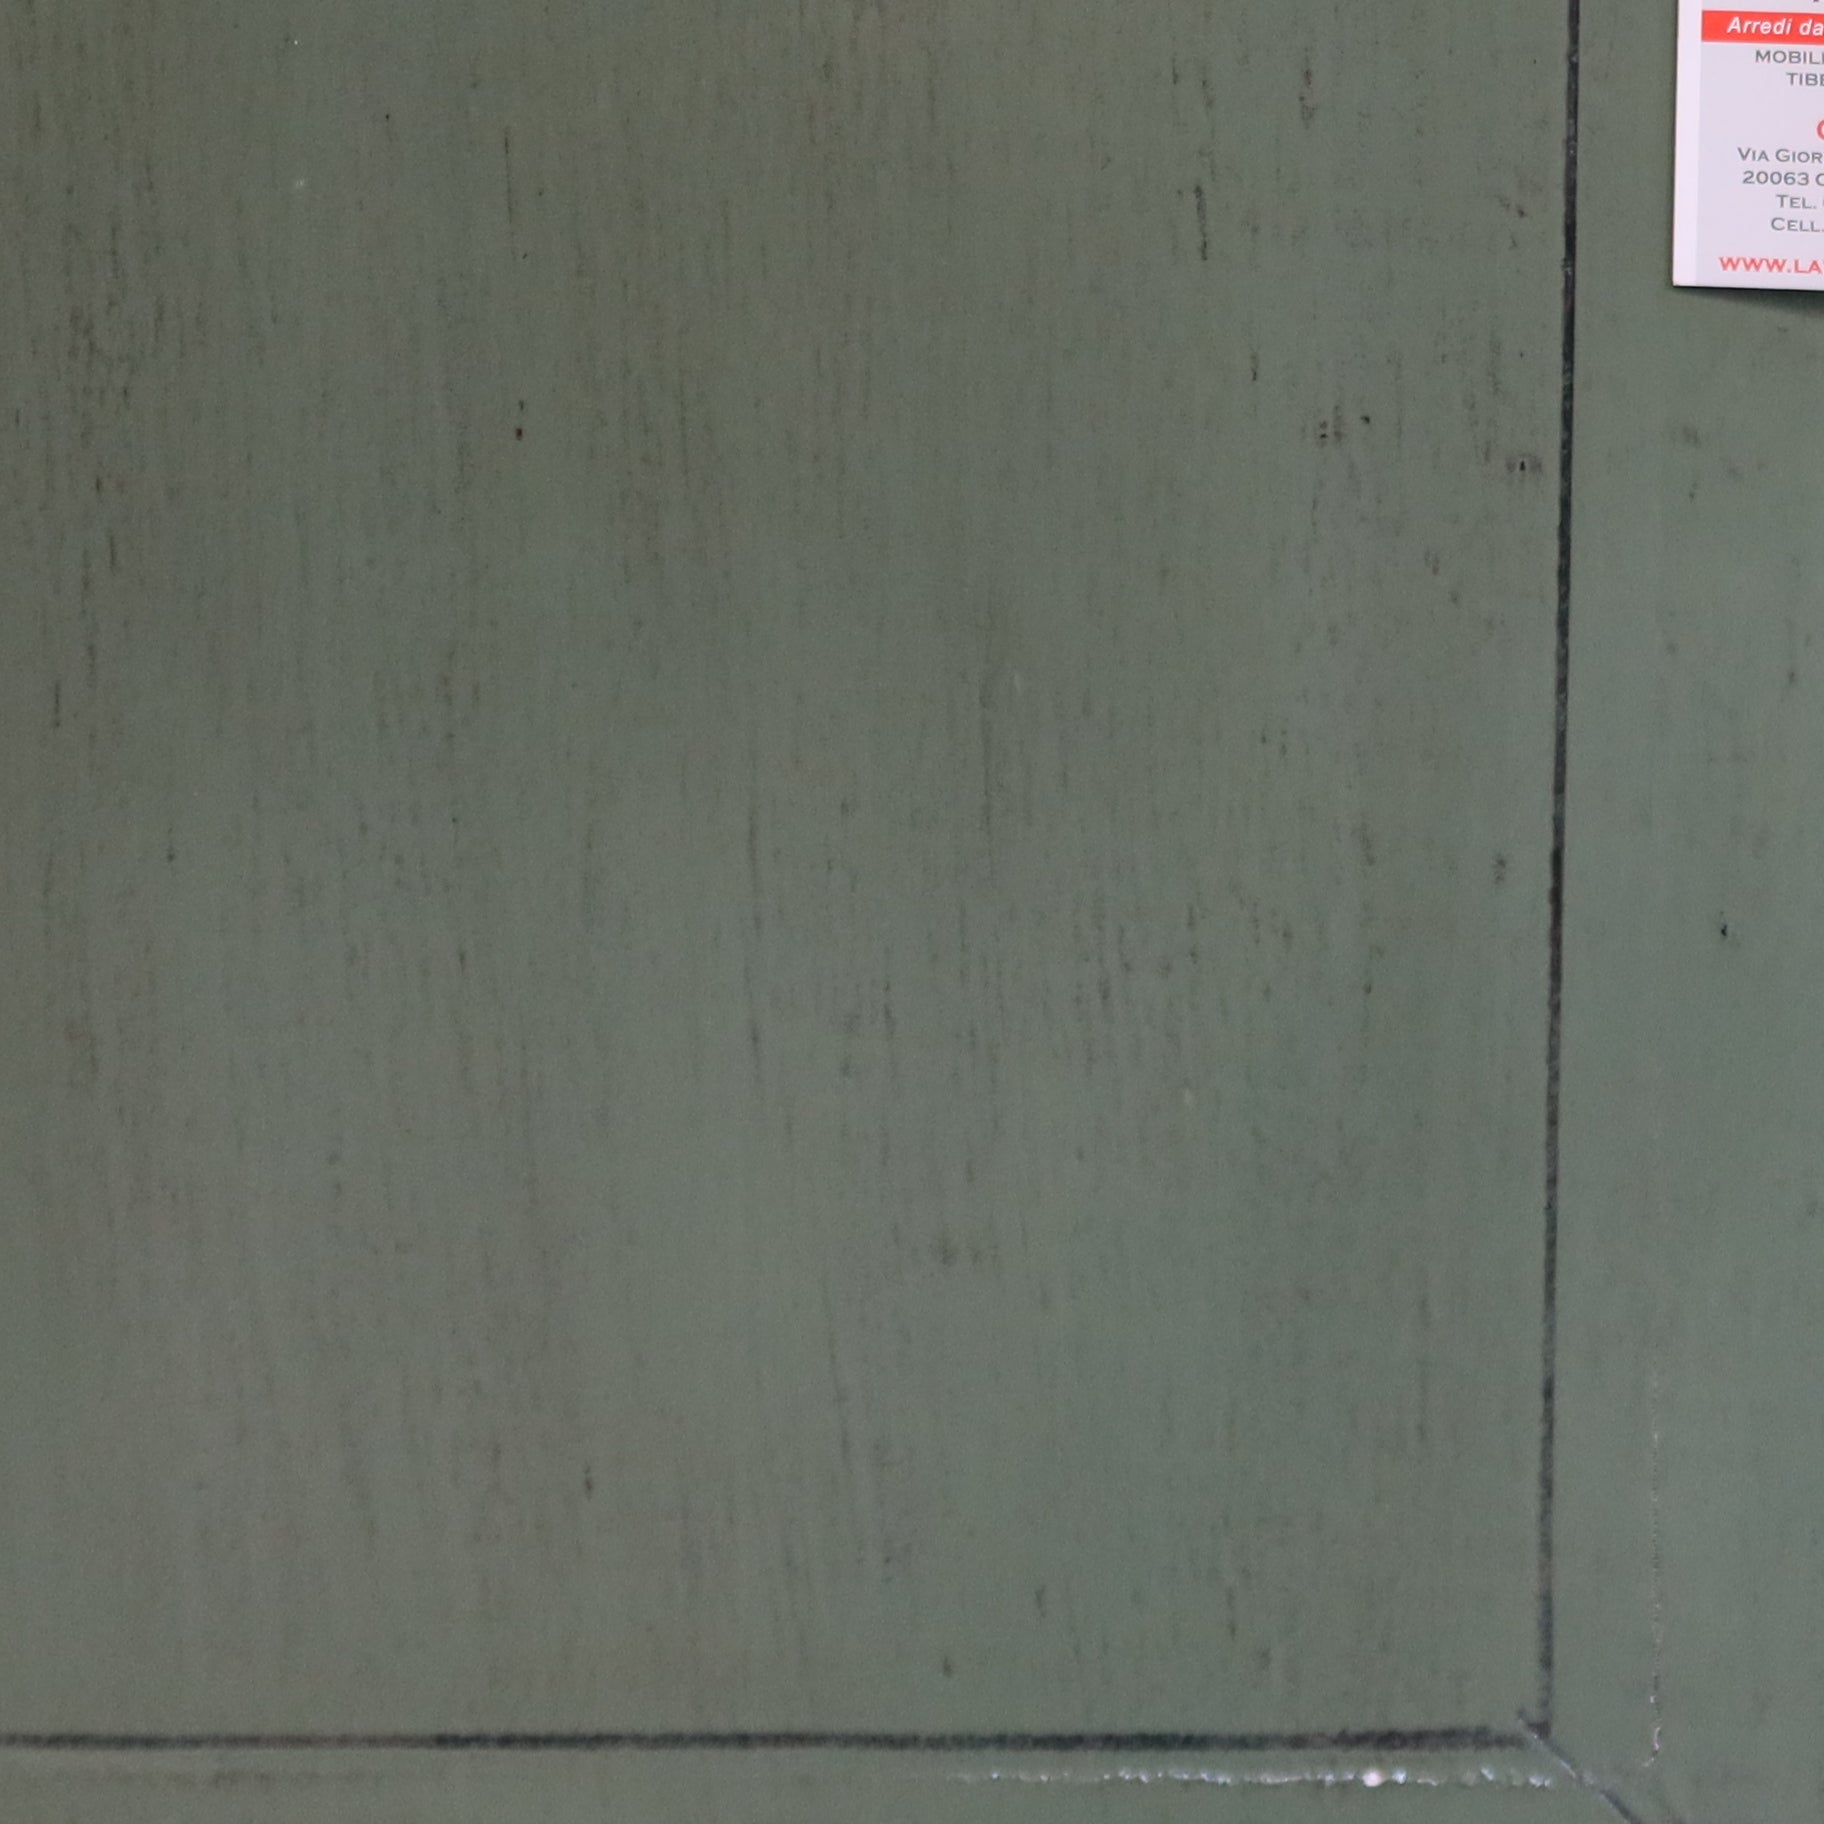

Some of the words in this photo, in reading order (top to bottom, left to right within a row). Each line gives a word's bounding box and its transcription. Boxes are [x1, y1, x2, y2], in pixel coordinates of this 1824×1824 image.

[1726, 16, 1793, 35] Arredi
[1799, 18, 1824, 37] da
[1742, 170, 1810, 187] 20063
